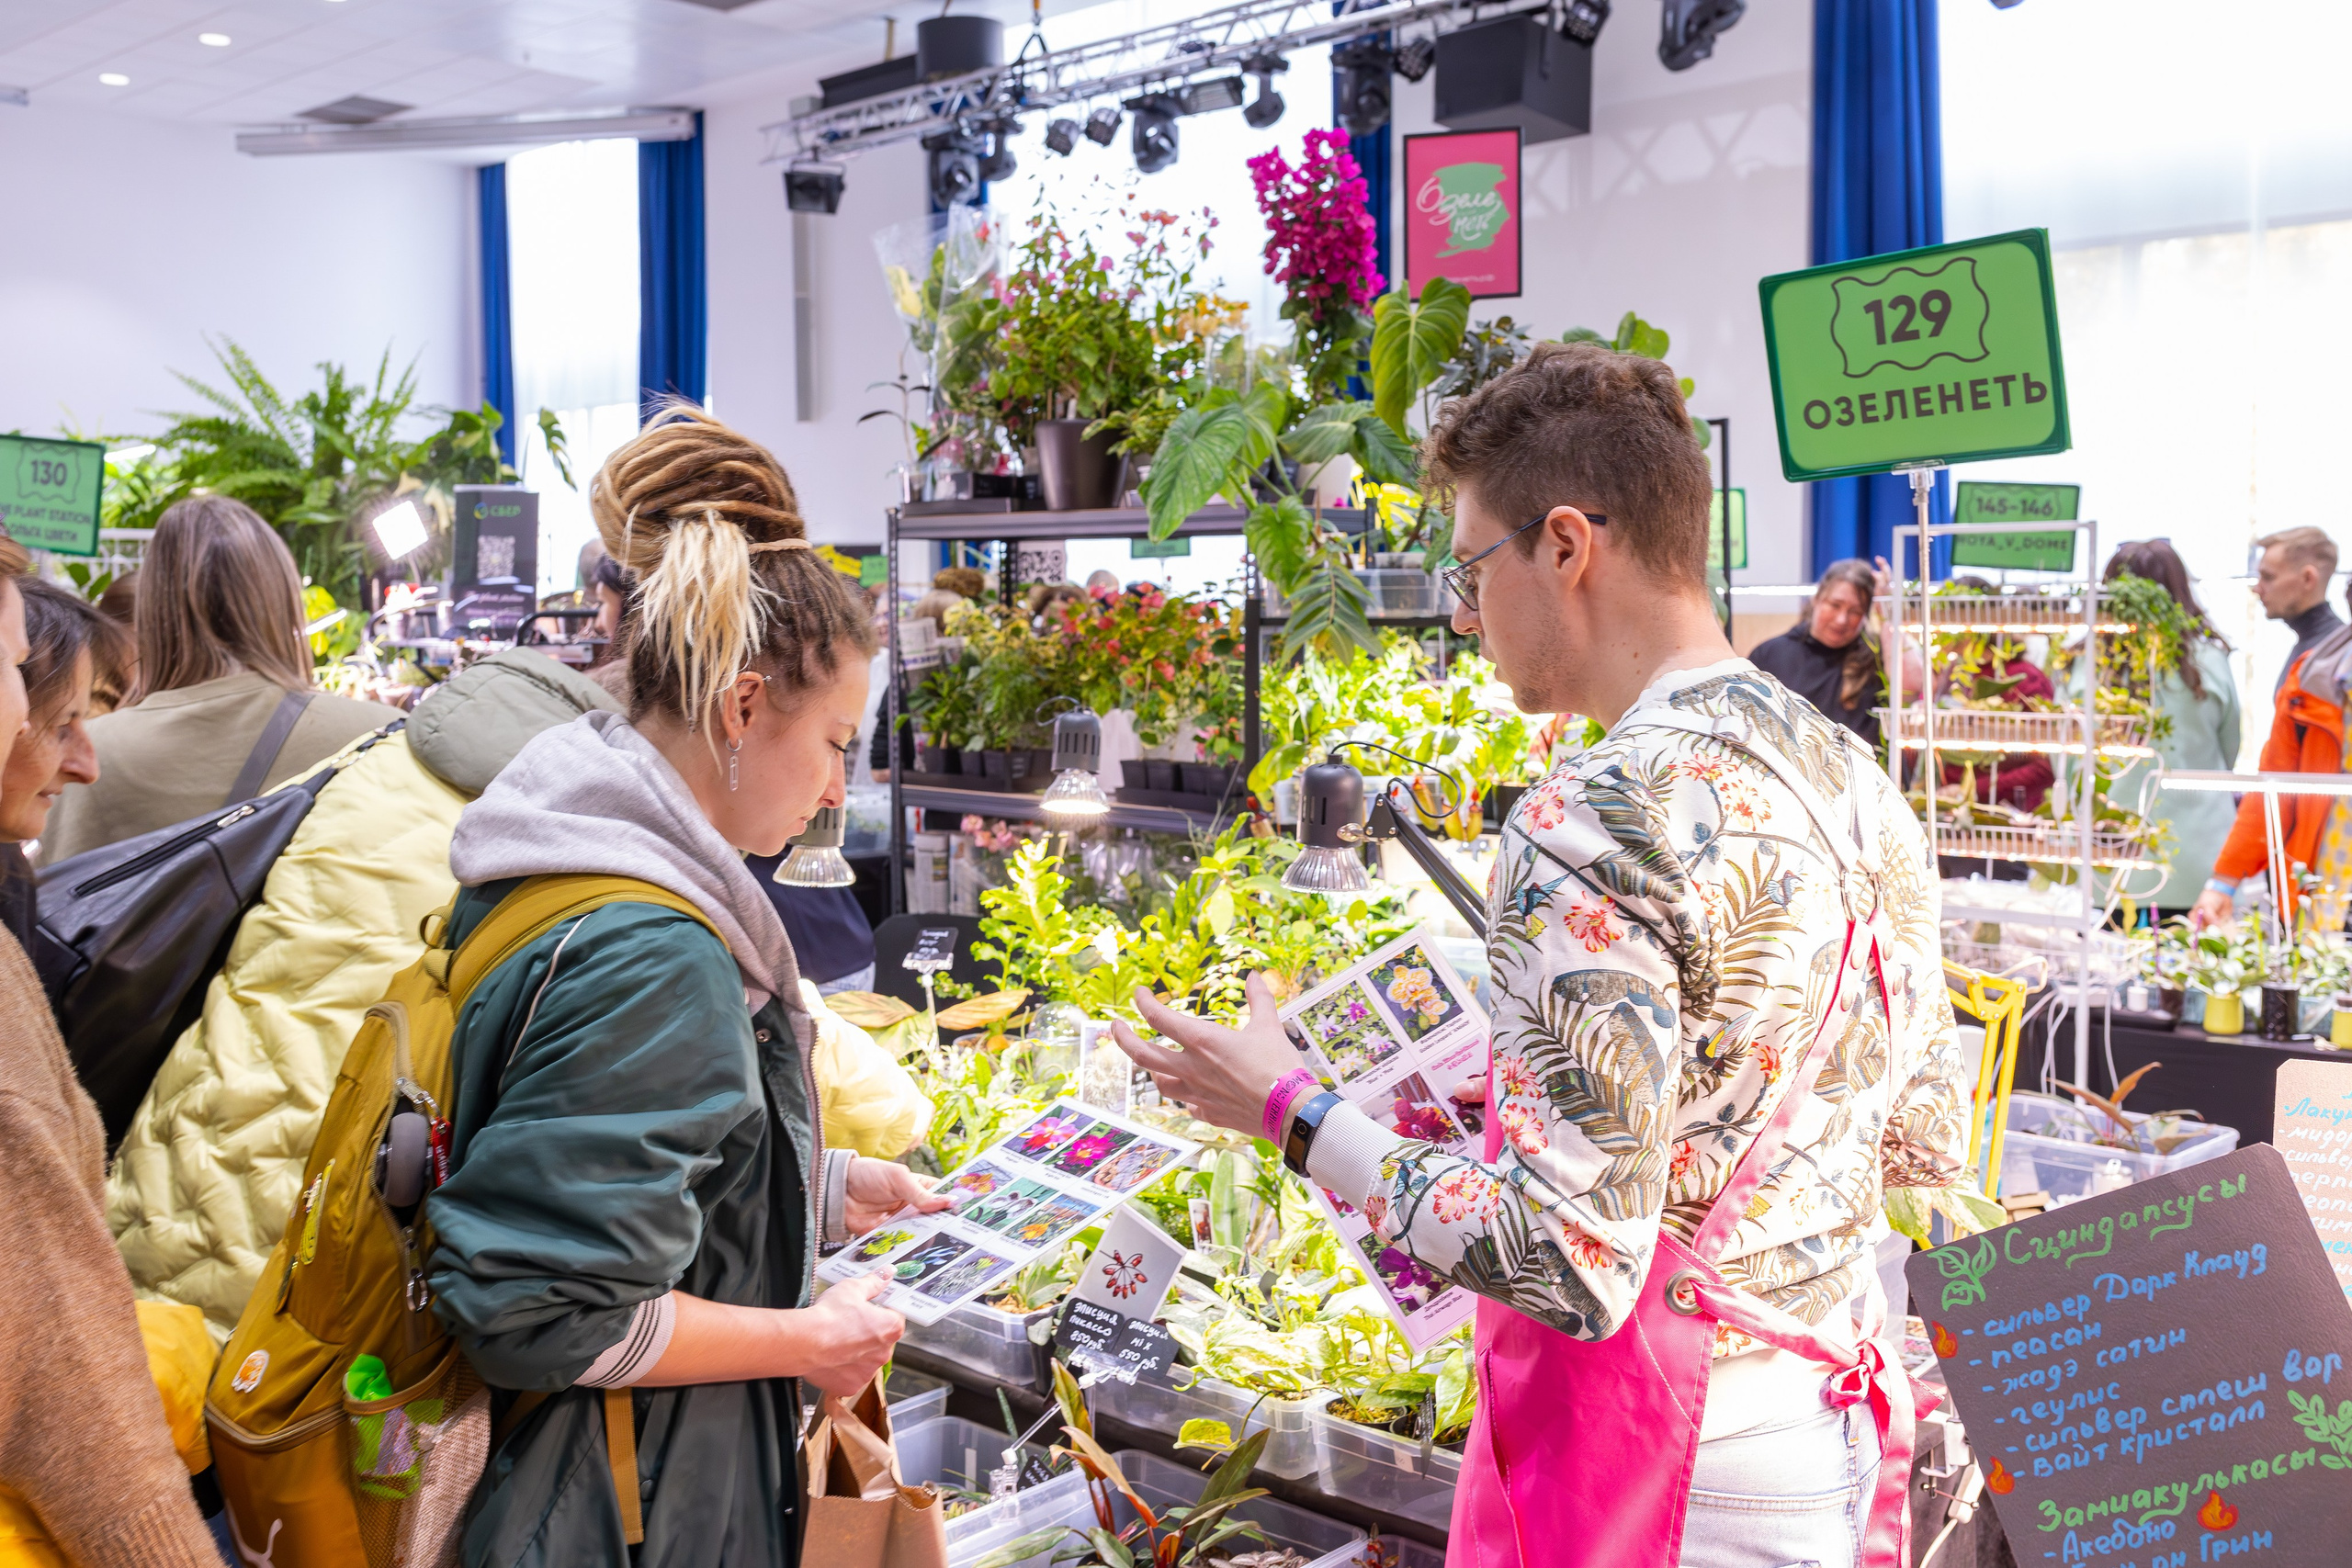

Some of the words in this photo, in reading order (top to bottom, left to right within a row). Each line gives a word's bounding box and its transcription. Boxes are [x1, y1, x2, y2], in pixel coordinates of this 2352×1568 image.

[1862, 289, 1952, 345] 129
[1804, 372, 2048, 430] ОЗЕЛЕНЕТЬ
[30, 460, 68, 487] 130
[1976, 496, 2054, 516] 145-146
[2004, 1173, 2246, 1269] Сциндапсусы
[2093, 1271, 2177, 1303] Дарк
[2184, 1243, 2267, 1280] Клауд
[1118, 1348, 1141, 1362] 550
[2199, 1529, 2272, 1562] Грин
